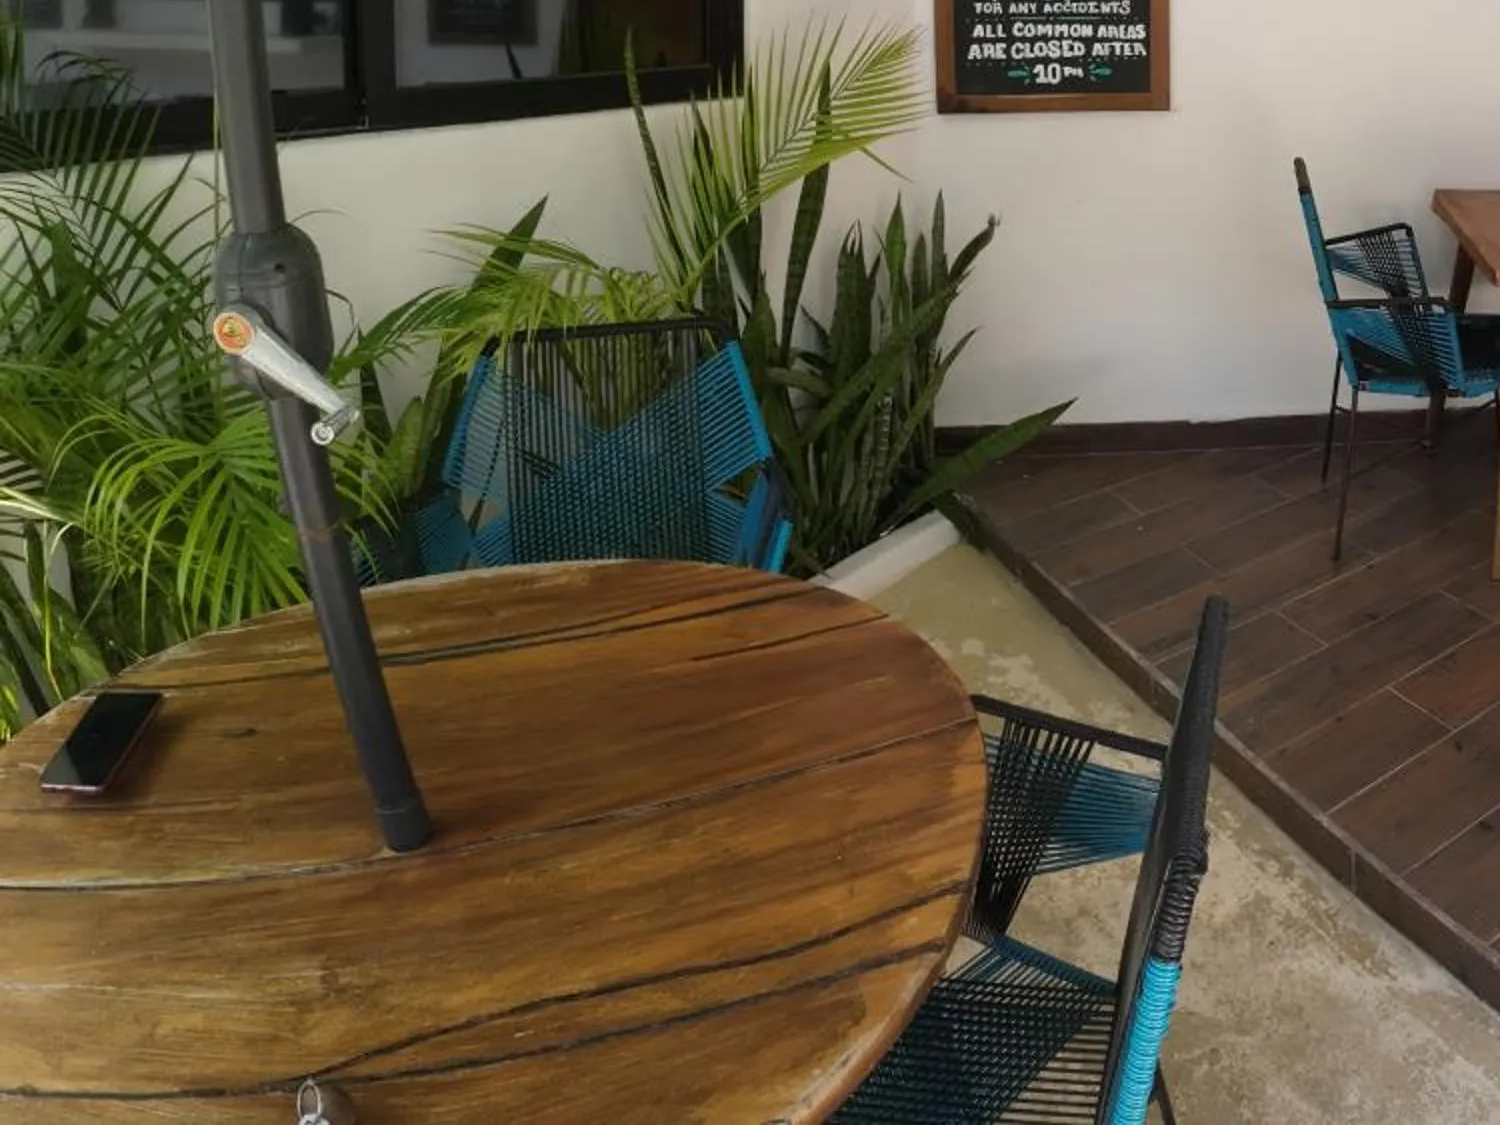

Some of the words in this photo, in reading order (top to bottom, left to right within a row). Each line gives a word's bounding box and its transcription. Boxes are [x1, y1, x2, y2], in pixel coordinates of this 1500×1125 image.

[973, 2, 1003, 15] FOR
[1009, 2, 1037, 14] ANY
[1043, 0, 1131, 15] ACCIDENTS
[972, 23, 1006, 38] ALL
[1012, 22, 1093, 38] COMMON
[1097, 24, 1146, 40] AREAS
[967, 43, 1007, 60] ARE
[1011, 40, 1086, 60] CLOSED
[1091, 42, 1147, 57] AFTER
